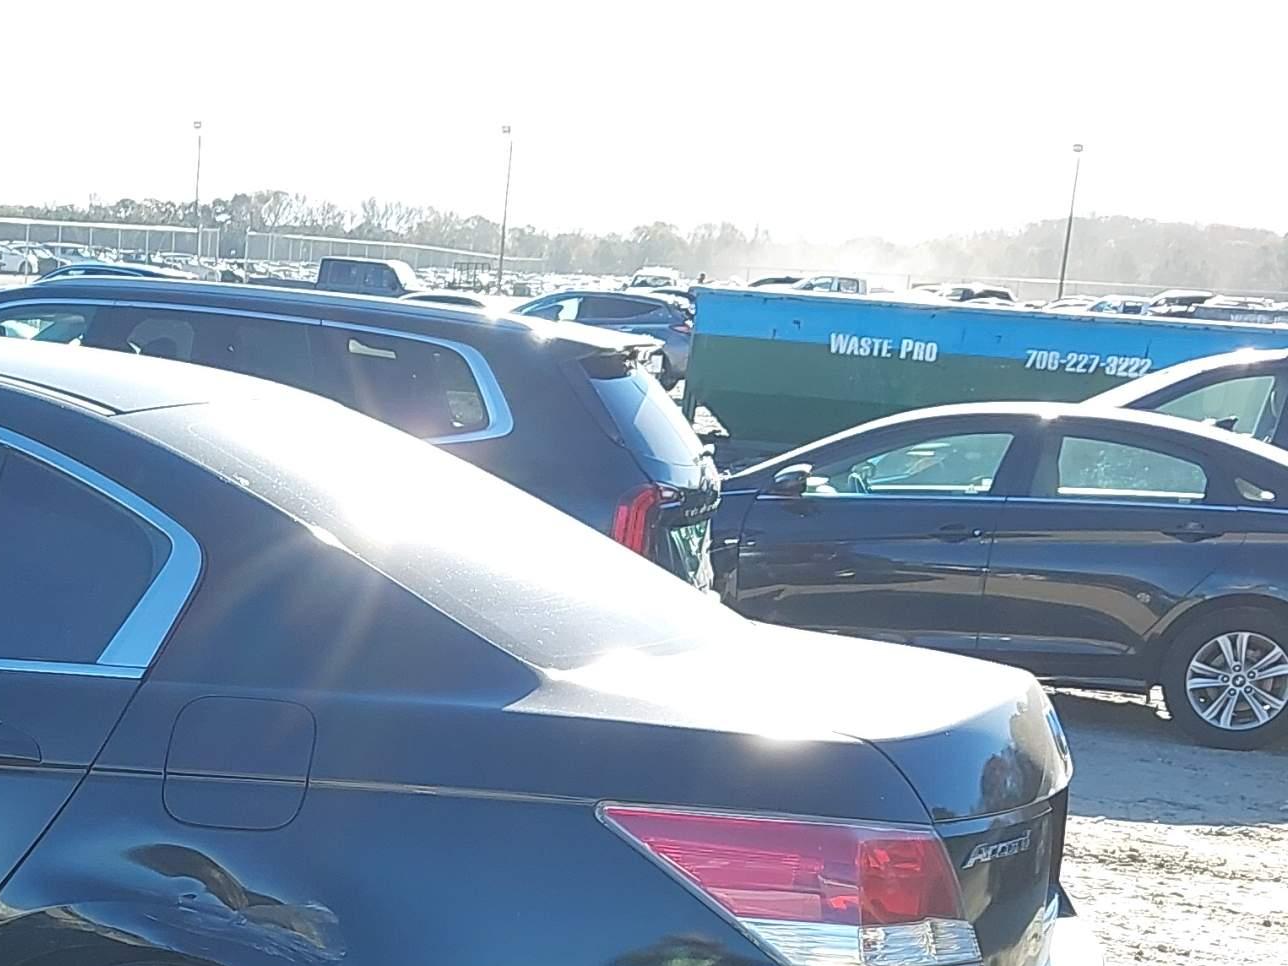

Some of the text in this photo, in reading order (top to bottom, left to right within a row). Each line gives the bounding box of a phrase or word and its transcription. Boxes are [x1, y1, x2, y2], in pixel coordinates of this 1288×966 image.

[830, 332, 938, 362] WASTE PRO
[1024, 349, 1152, 378] 706-227-3222
